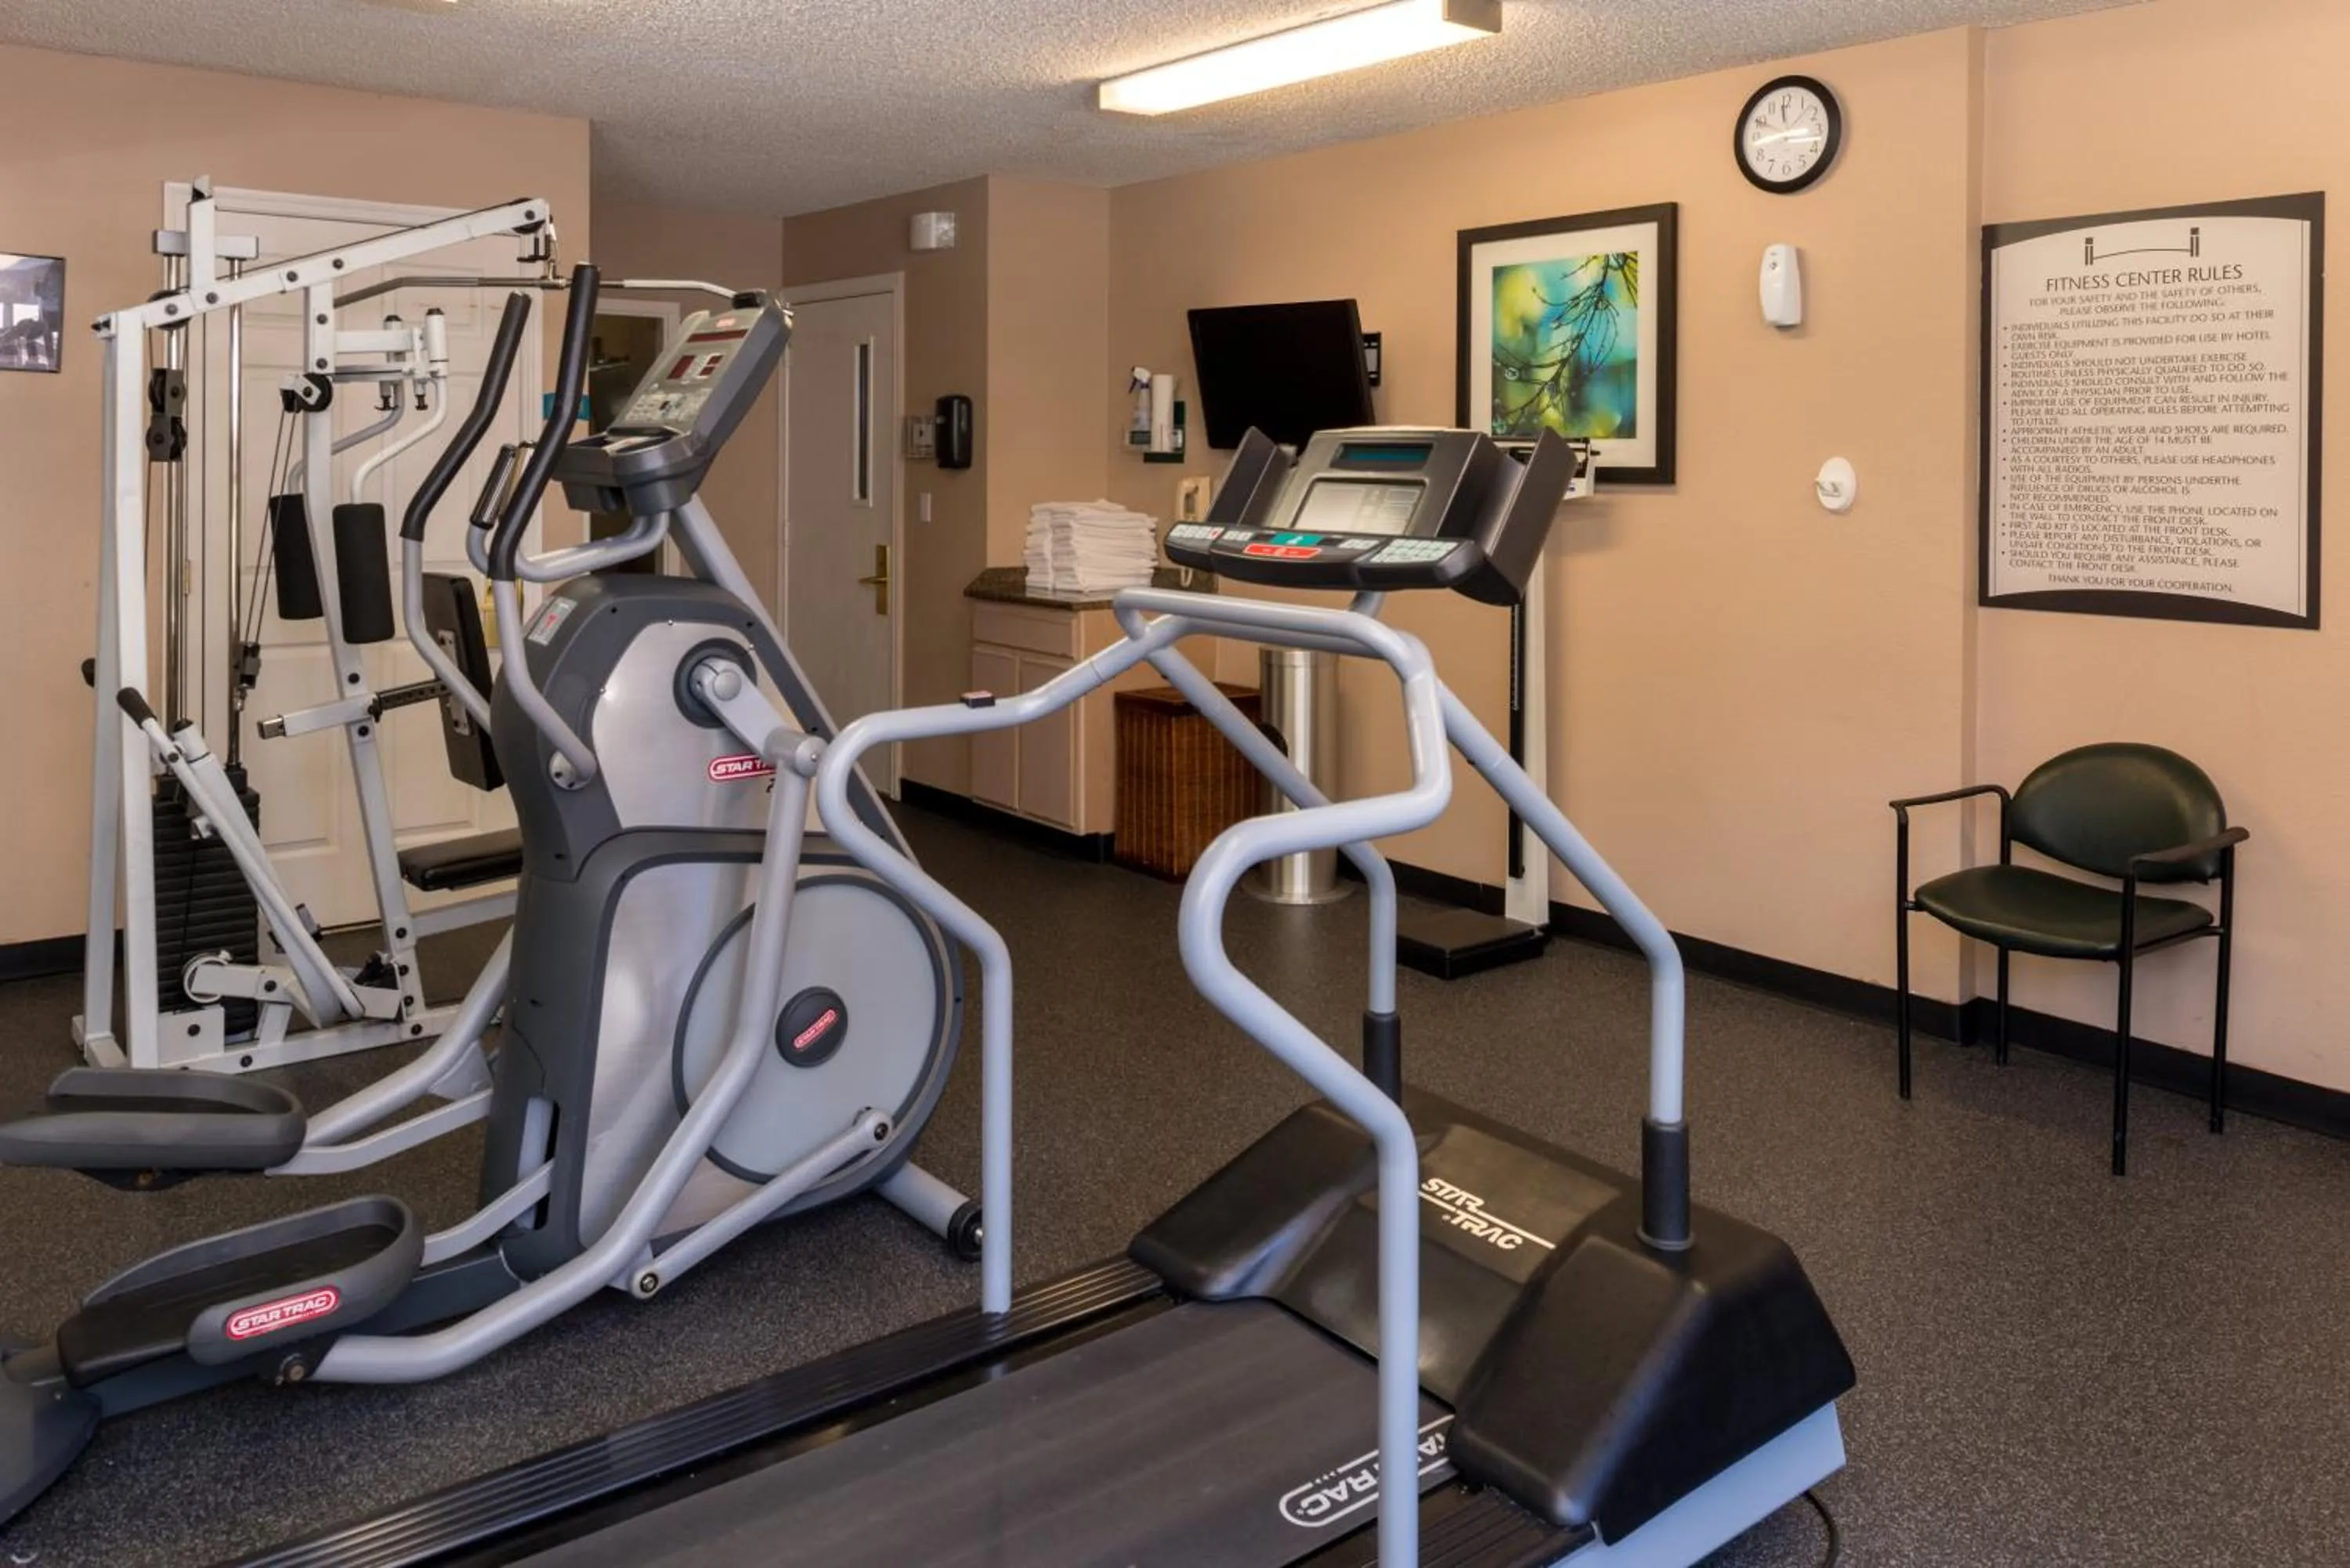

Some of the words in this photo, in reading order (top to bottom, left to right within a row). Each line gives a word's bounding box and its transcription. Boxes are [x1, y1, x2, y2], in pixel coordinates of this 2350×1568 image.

[1768, 101, 1776, 114] 11
[1782, 93, 1792, 109] 12
[1810, 105, 1818, 121] 2
[1809, 140, 1818, 153] 4
[1755, 148, 1764, 161] 8
[1798, 154, 1806, 169] 5
[1767, 158, 1775, 173] 7
[1782, 161, 1792, 175] 6
[2046, 273, 2110, 291] FITNESS
[2115, 269, 2181, 287] CENTER
[2188, 264, 2243, 283] RULES
[714, 761, 753, 774] STAR
[1421, 1177, 1484, 1212] STAR
[1450, 1210, 1523, 1249] TRAC
[237, 1310, 281, 1331] STAR
[282, 1295, 327, 1317] TRAC
[1300, 1463, 1379, 1516] RAC
